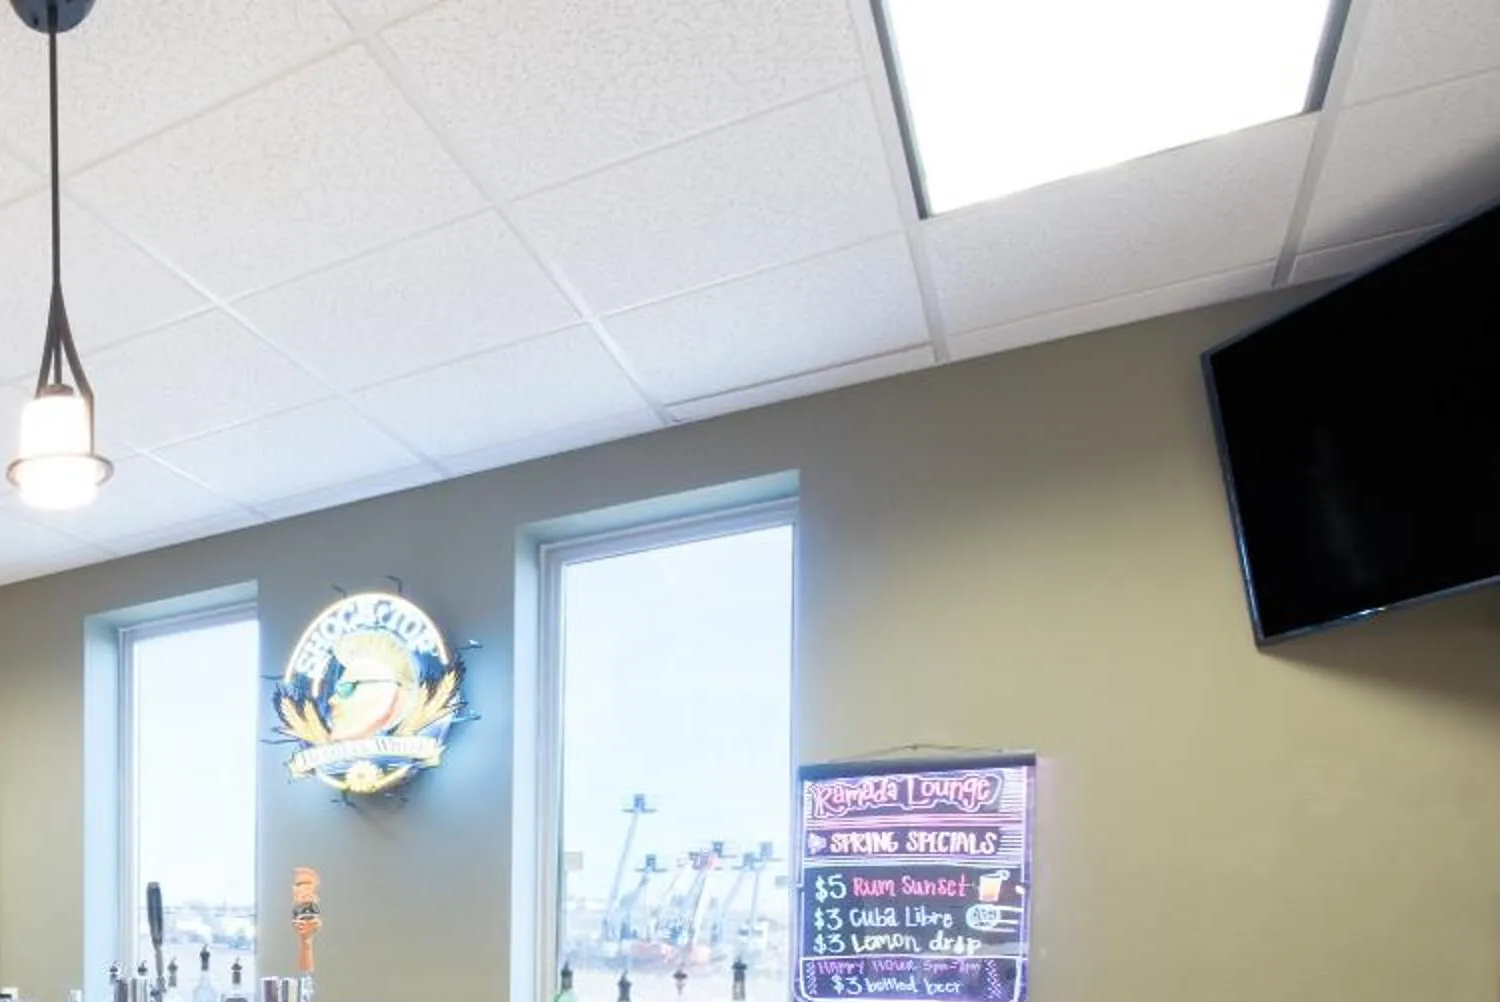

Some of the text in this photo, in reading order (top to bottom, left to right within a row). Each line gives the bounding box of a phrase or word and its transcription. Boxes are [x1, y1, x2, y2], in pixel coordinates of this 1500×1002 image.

[814, 775, 991, 813] Ramada Lounge
[830, 830, 998, 855] SPRING SPECIALS
[815, 873, 968, 902] $5 Rum Sunset
[814, 909, 843, 931] $3
[849, 907, 900, 928] Cuba
[906, 906, 953, 928] Libre
[813, 930, 982, 956] $3 Lemon drop
[831, 974, 863, 995] $3
[924, 977, 962, 995] beer
